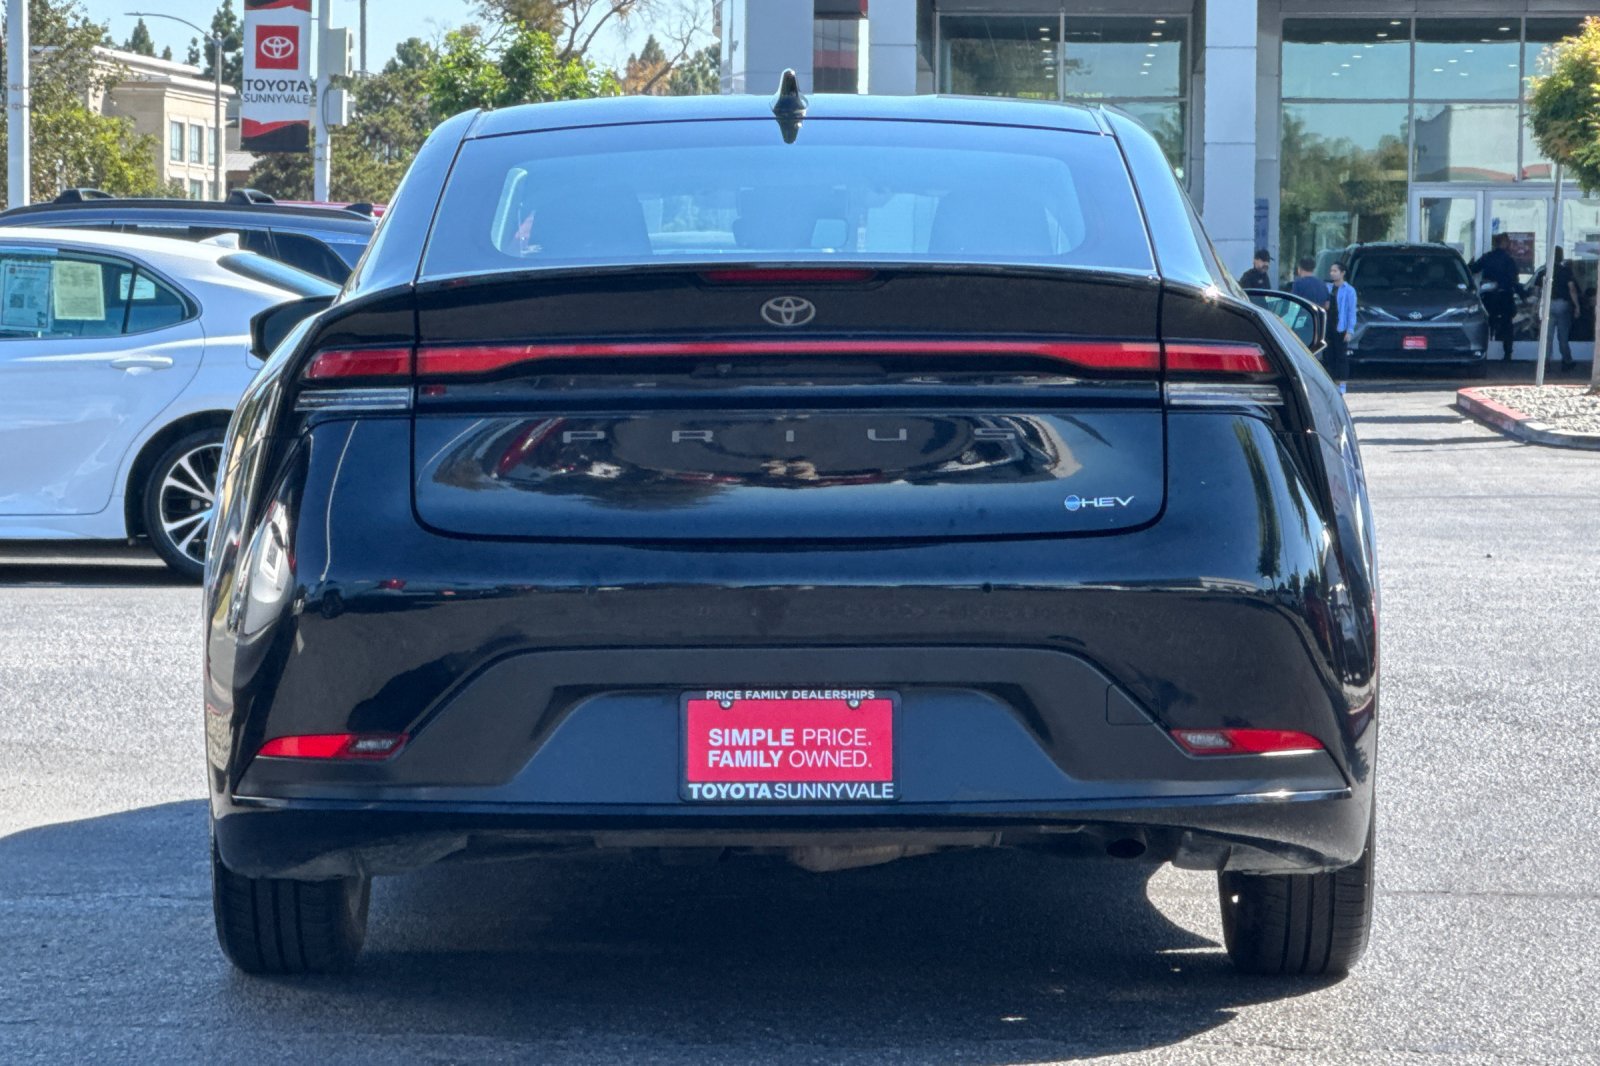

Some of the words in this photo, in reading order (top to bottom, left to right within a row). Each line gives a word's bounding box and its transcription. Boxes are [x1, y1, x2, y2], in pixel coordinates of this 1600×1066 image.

[244, 79, 309, 92] TOYOTA
[243, 93, 309, 104] SUNNYVALE
[562, 427, 1016, 443] PRIUS
[1081, 495, 1135, 508] HEV
[706, 690, 742, 700] PRICE
[745, 690, 788, 700] FAMILY
[792, 690, 875, 700] DEALERSHIPS
[708, 728, 795, 746] SIMPLE
[802, 728, 872, 746] PRICE.
[708, 750, 783, 768] FAMILY
[789, 750, 872, 768] OWNED.
[688, 783, 772, 800] TOYOTA
[774, 783, 894, 799] SUNNYVALE
